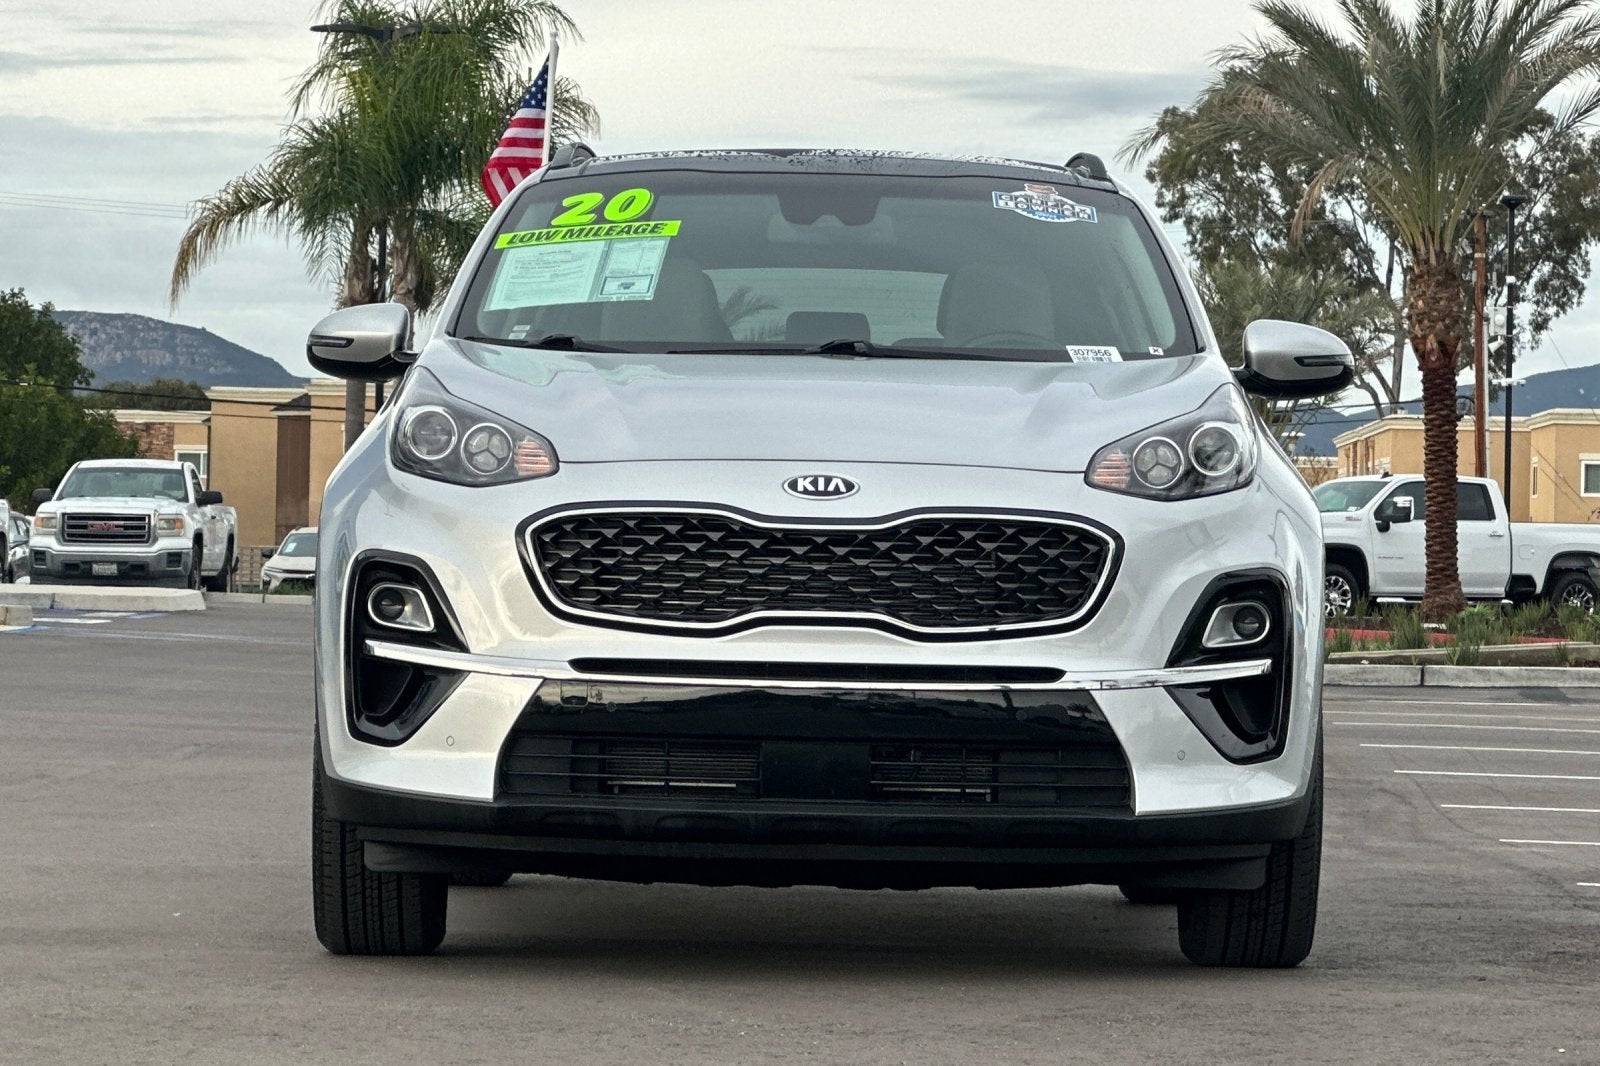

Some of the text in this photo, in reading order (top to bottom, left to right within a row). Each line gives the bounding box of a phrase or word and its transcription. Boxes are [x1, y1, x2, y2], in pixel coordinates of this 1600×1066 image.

[551, 188, 653, 226] 20
[506, 222, 665, 245] LOW MILEAGE
[1070, 348, 1112, 357] 307956
[797, 476, 847, 493] KIA
[88, 520, 124, 531] GMC
